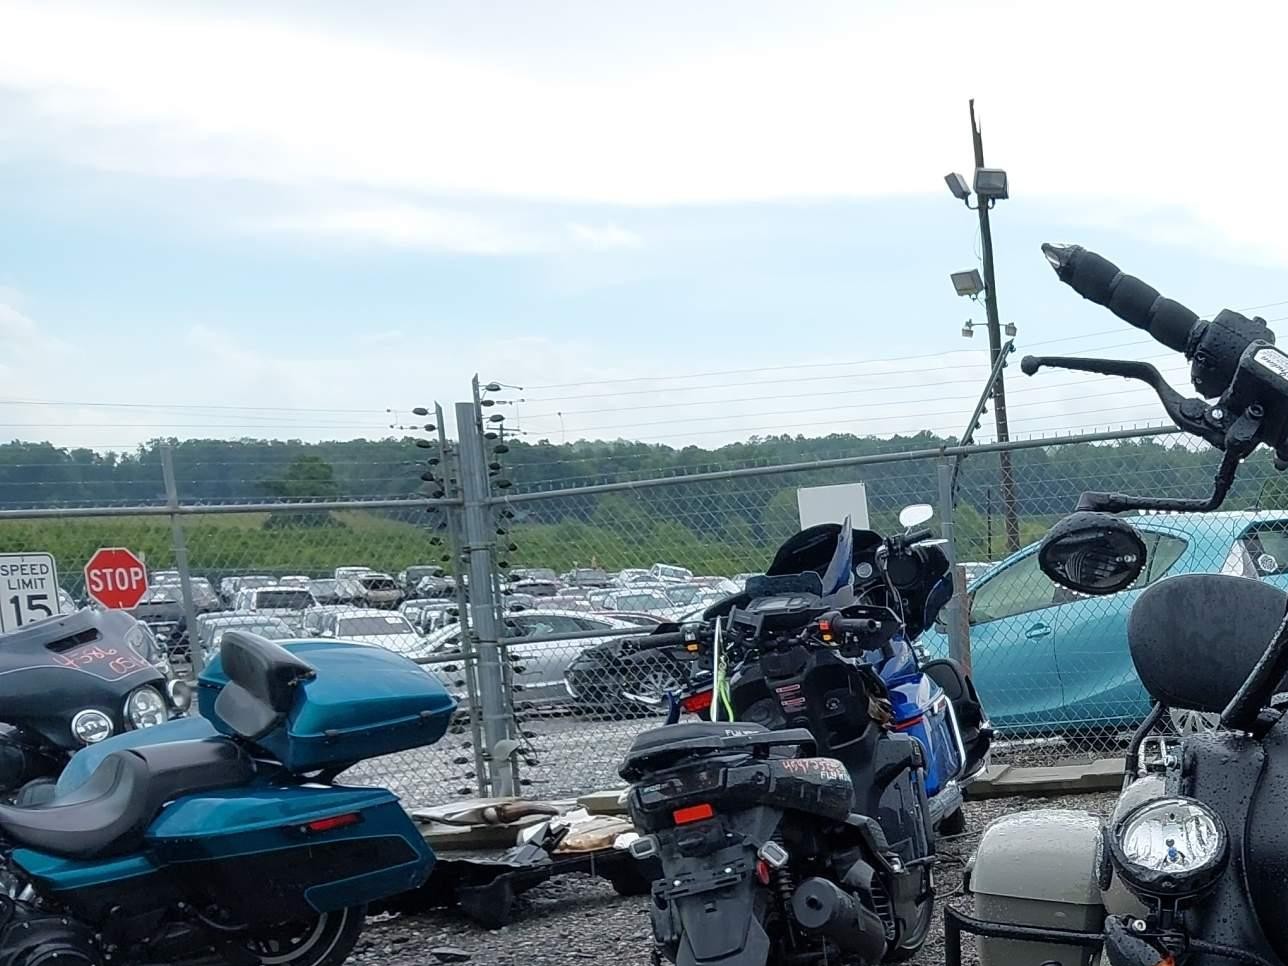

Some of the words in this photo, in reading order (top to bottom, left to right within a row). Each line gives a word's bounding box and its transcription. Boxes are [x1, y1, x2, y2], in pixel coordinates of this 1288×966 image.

[0, 563, 49, 576] SPEED
[8, 577, 46, 590] LIMIT
[89, 567, 143, 592] STOP
[10, 594, 53, 627] 15
[820, 771, 836, 780] FLY
